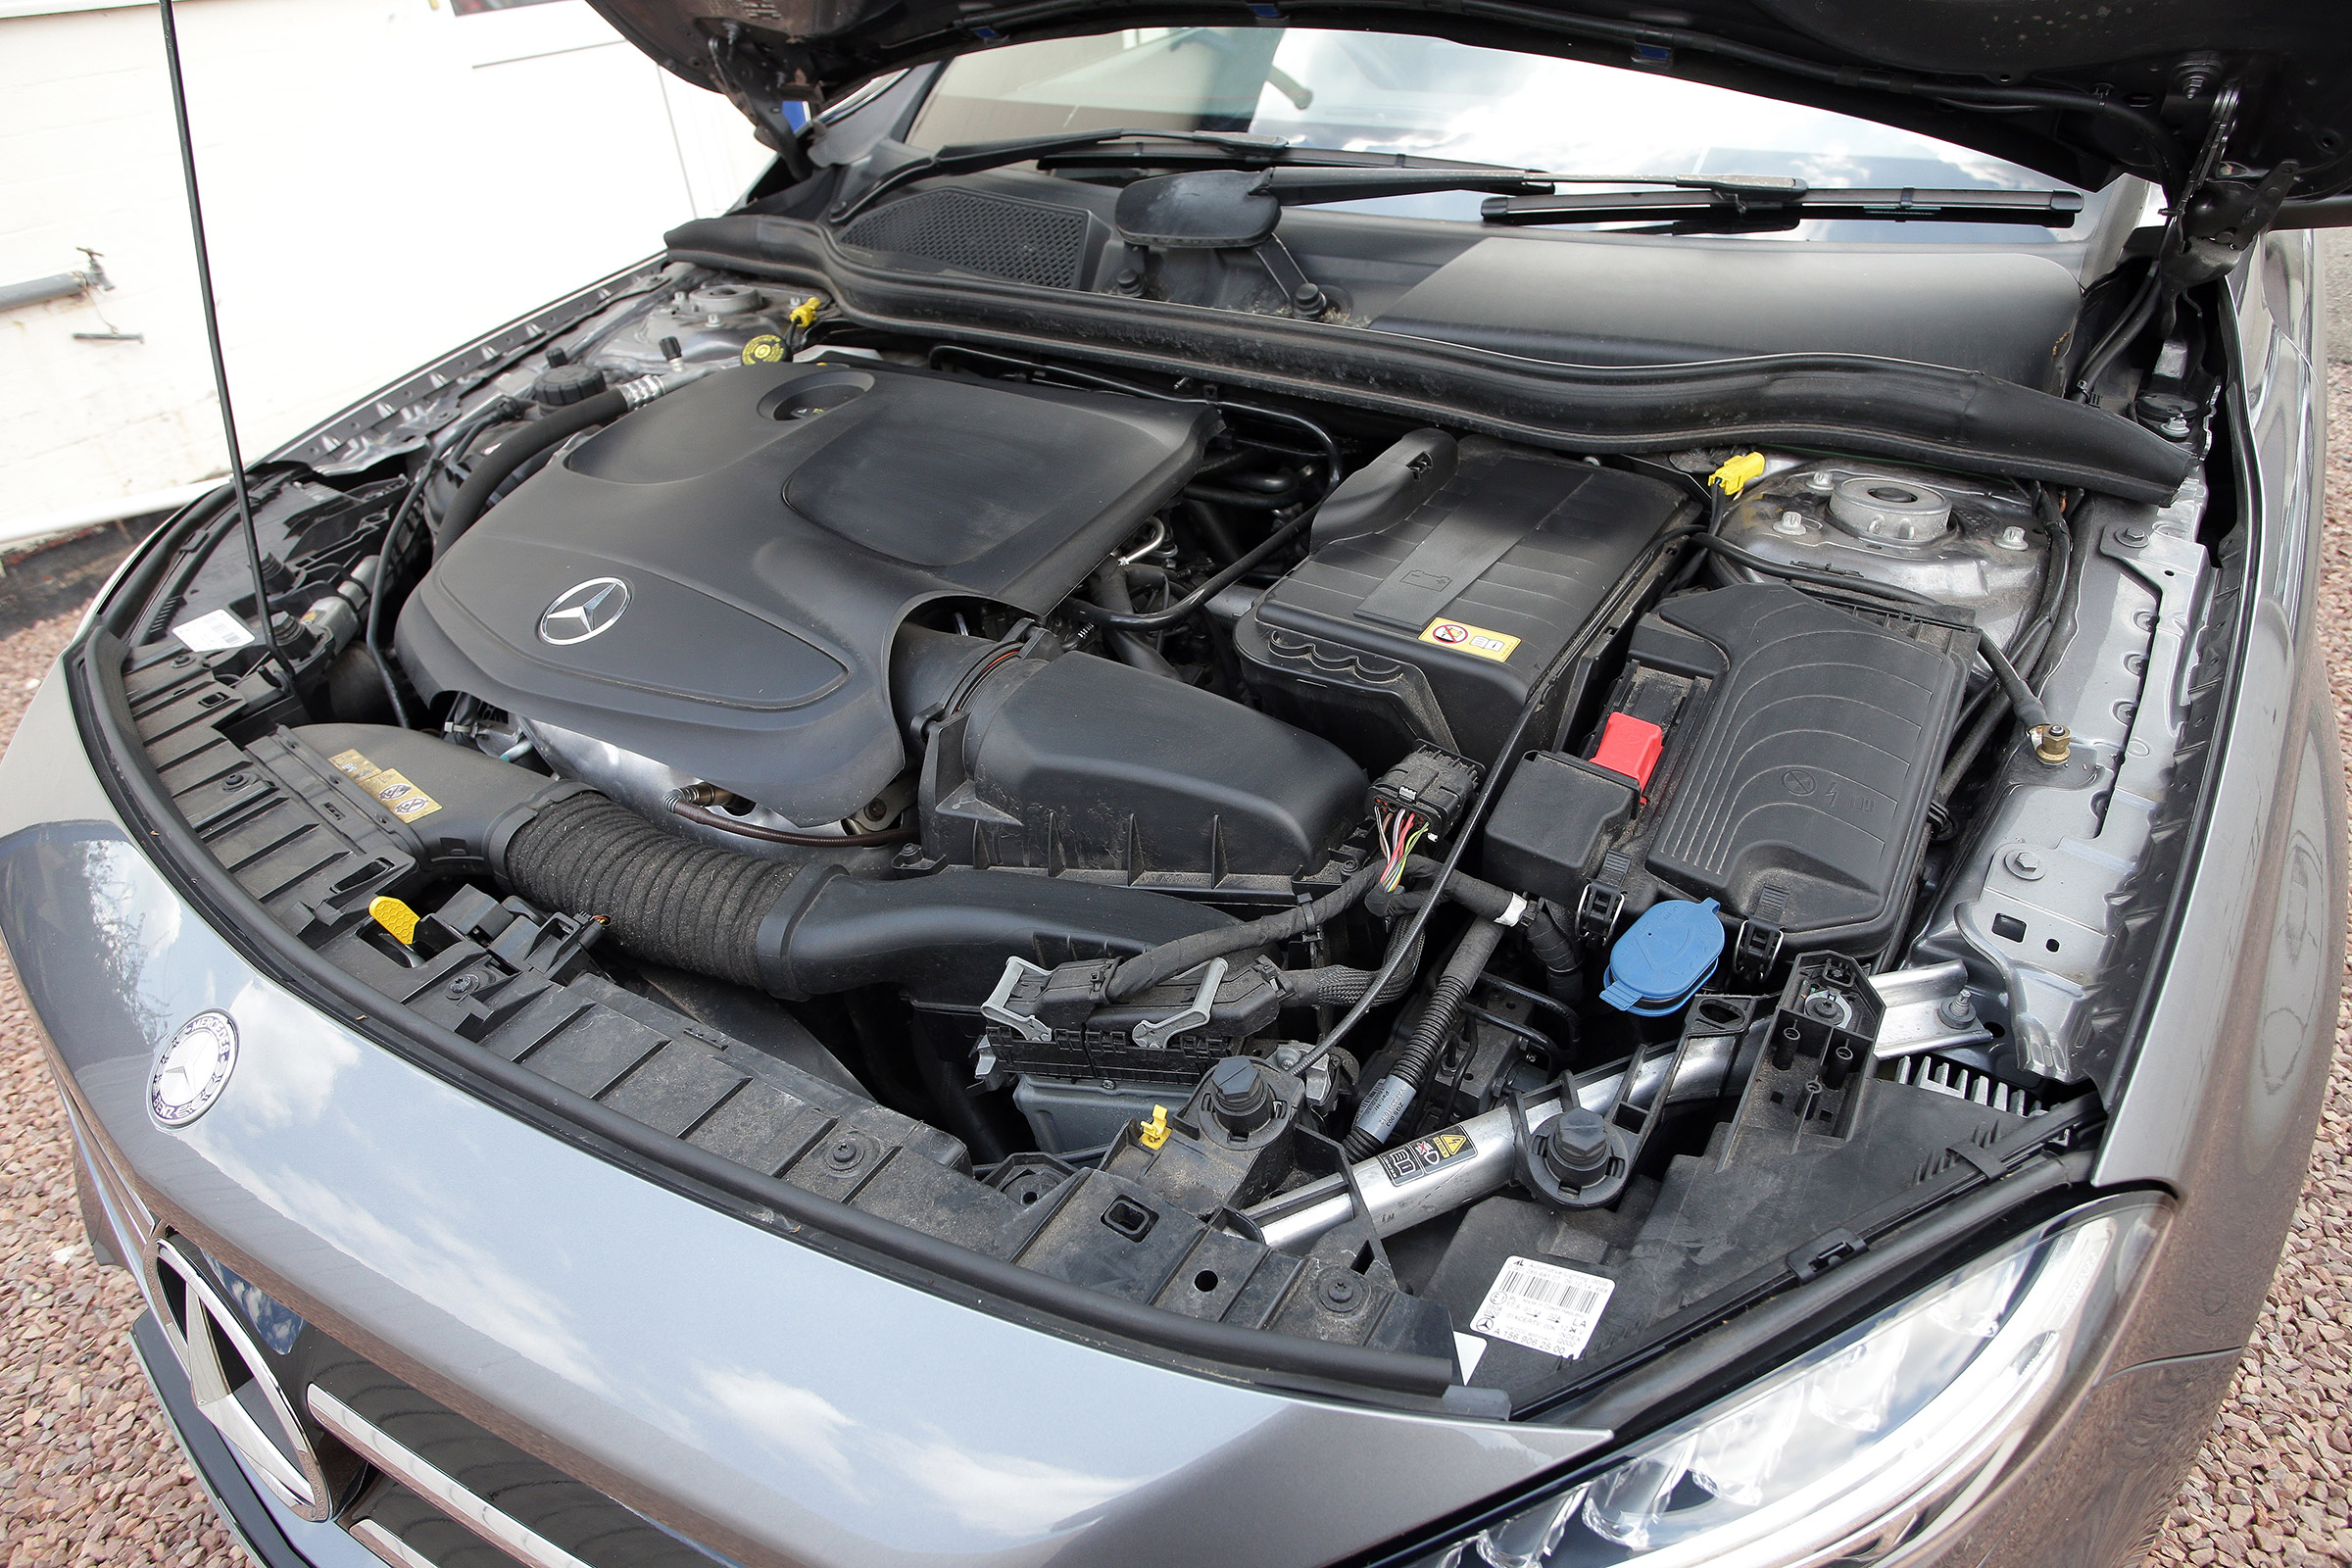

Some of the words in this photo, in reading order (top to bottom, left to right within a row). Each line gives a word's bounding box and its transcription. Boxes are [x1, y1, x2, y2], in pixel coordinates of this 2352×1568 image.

[192, 1017, 229, 1054] MERCEDES
[153, 1097, 175, 1118] BENZ
[1519, 1335, 1539, 1347] 906
[1539, 1341, 1552, 1350] 25
[1551, 1345, 1566, 1354] 00
